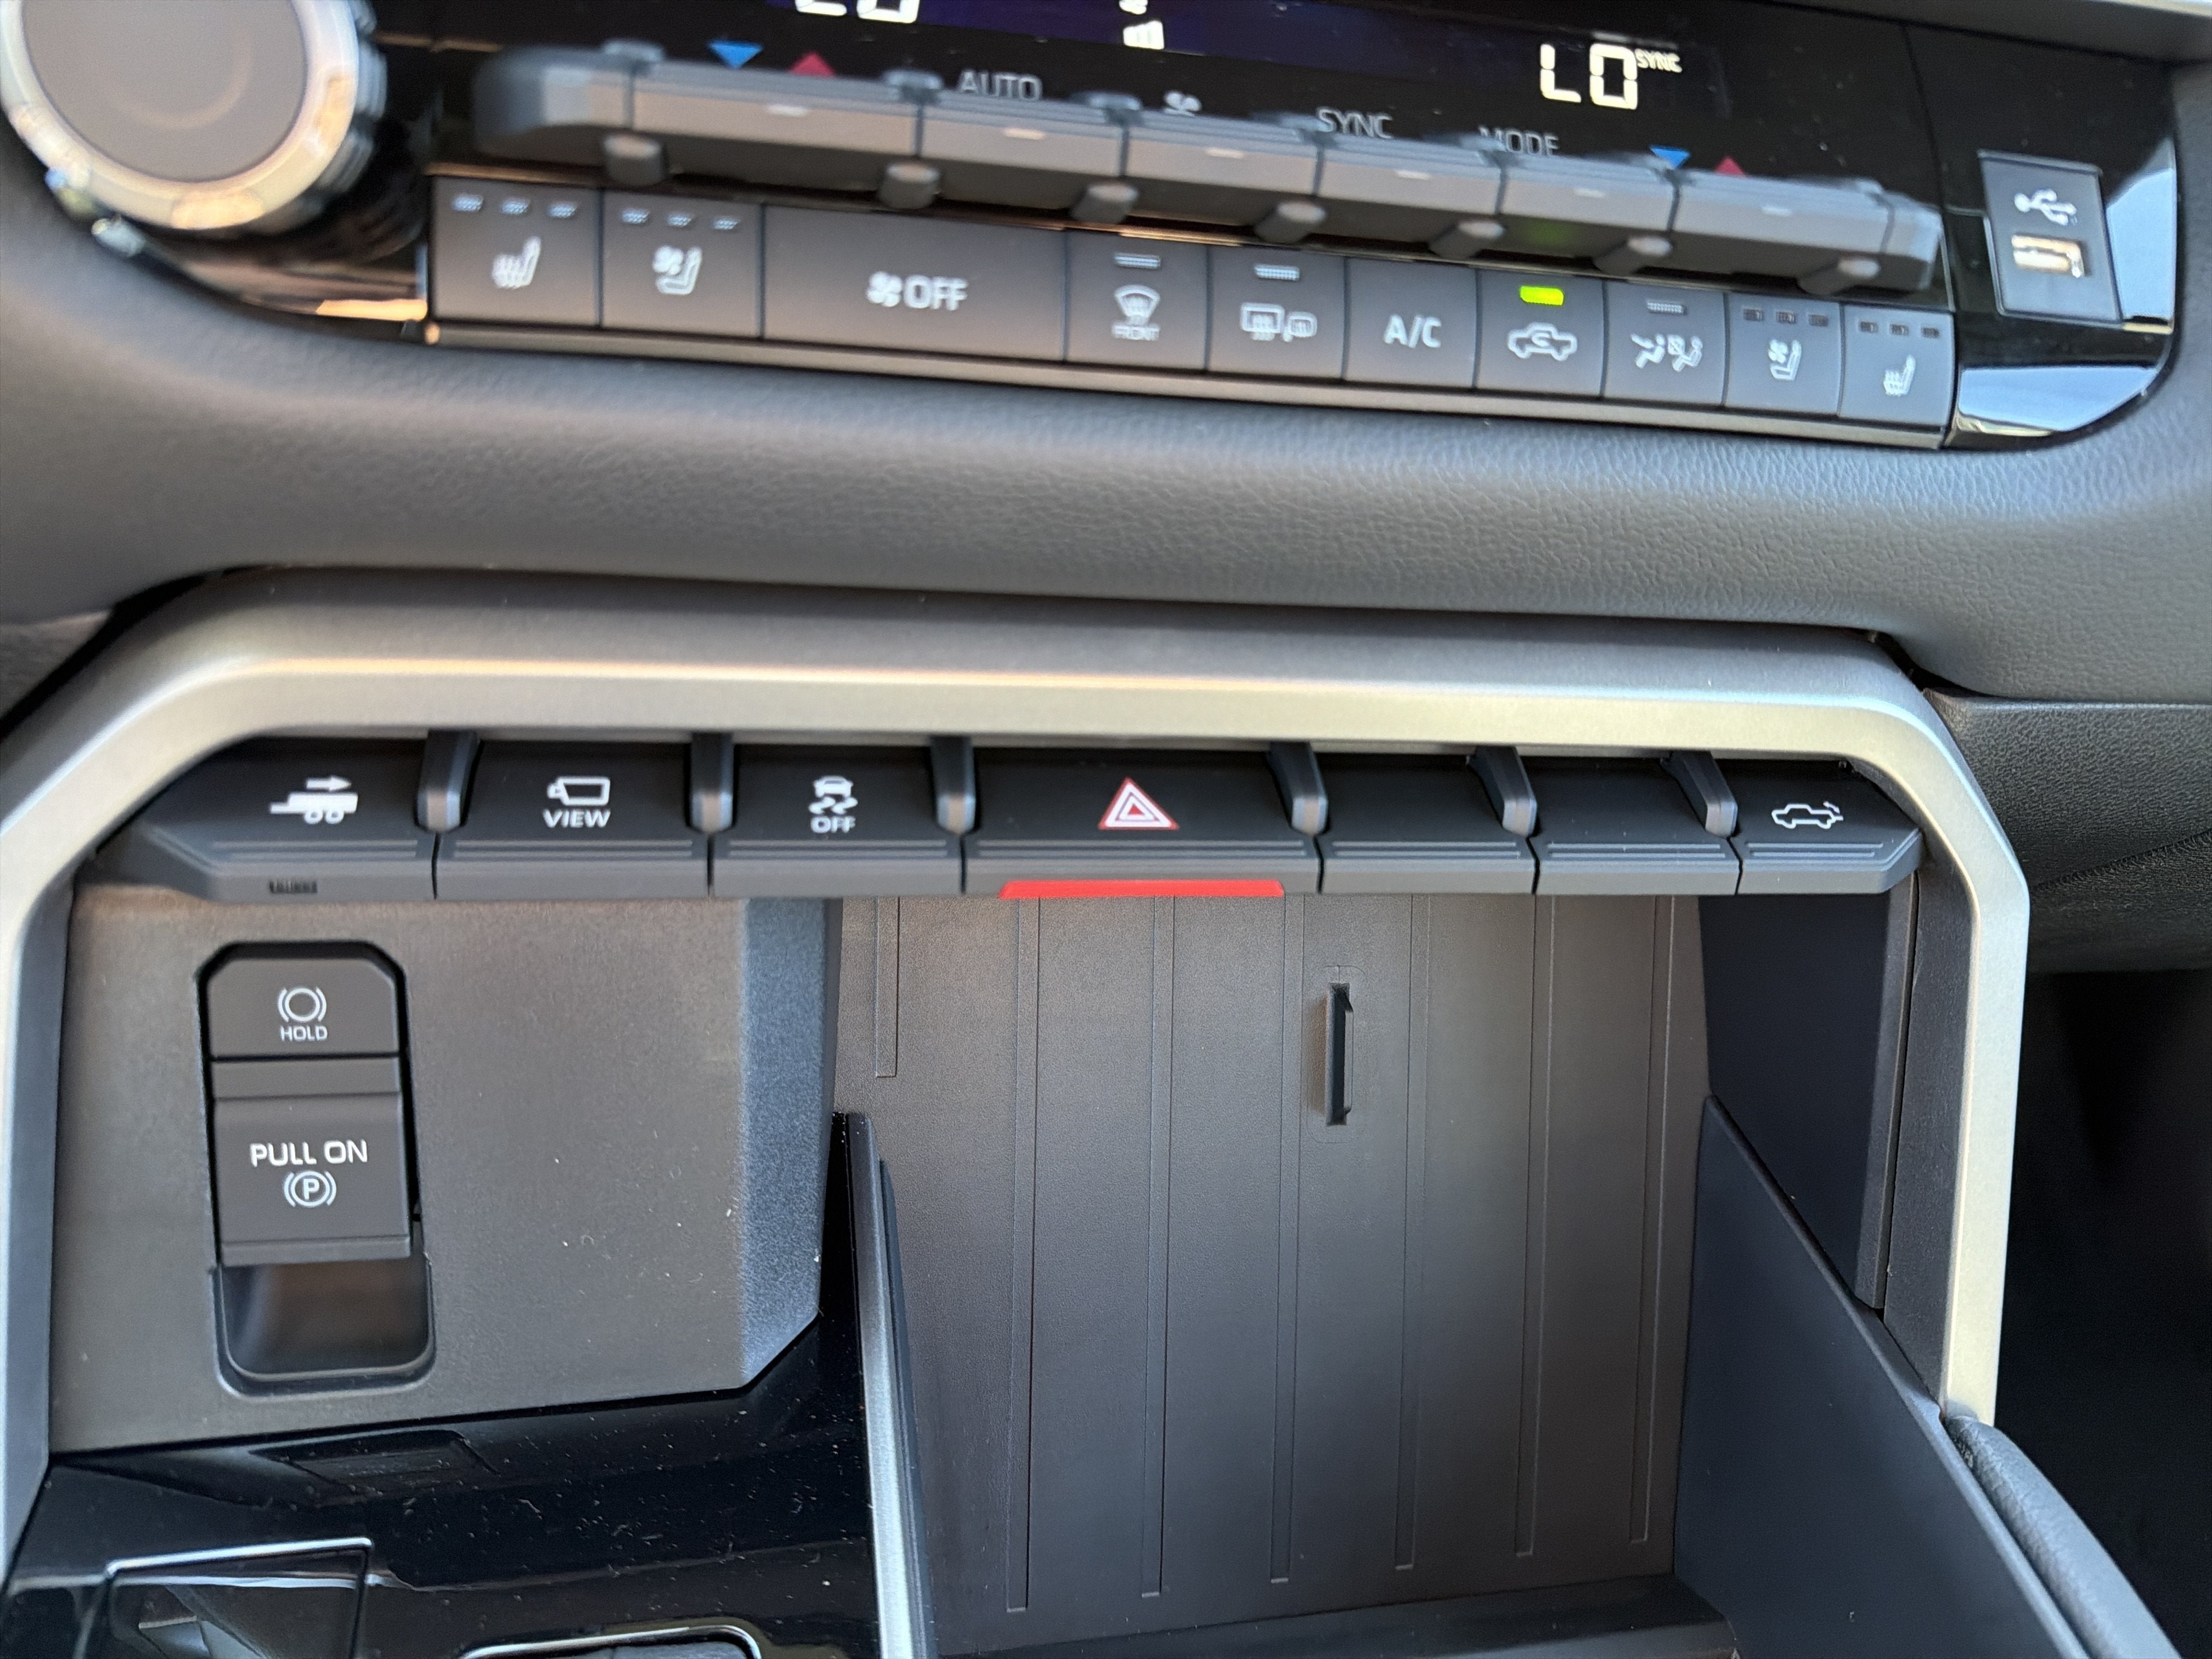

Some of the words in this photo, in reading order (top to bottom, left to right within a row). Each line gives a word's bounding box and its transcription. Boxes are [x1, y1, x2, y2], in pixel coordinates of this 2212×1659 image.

[1635, 48, 1683, 73] SYNC
[959, 69, 1042, 101] AUTO
[1317, 107, 1393, 139] SYNC
[904, 275, 968, 311] OFF
[1384, 313, 1442, 348] A/C
[543, 809, 611, 828] VIEW
[810, 816, 856, 833] OFF
[280, 1025, 328, 1041] HOLD
[250, 1142, 317, 1167] PULL
[324, 1139, 368, 1163] ON
